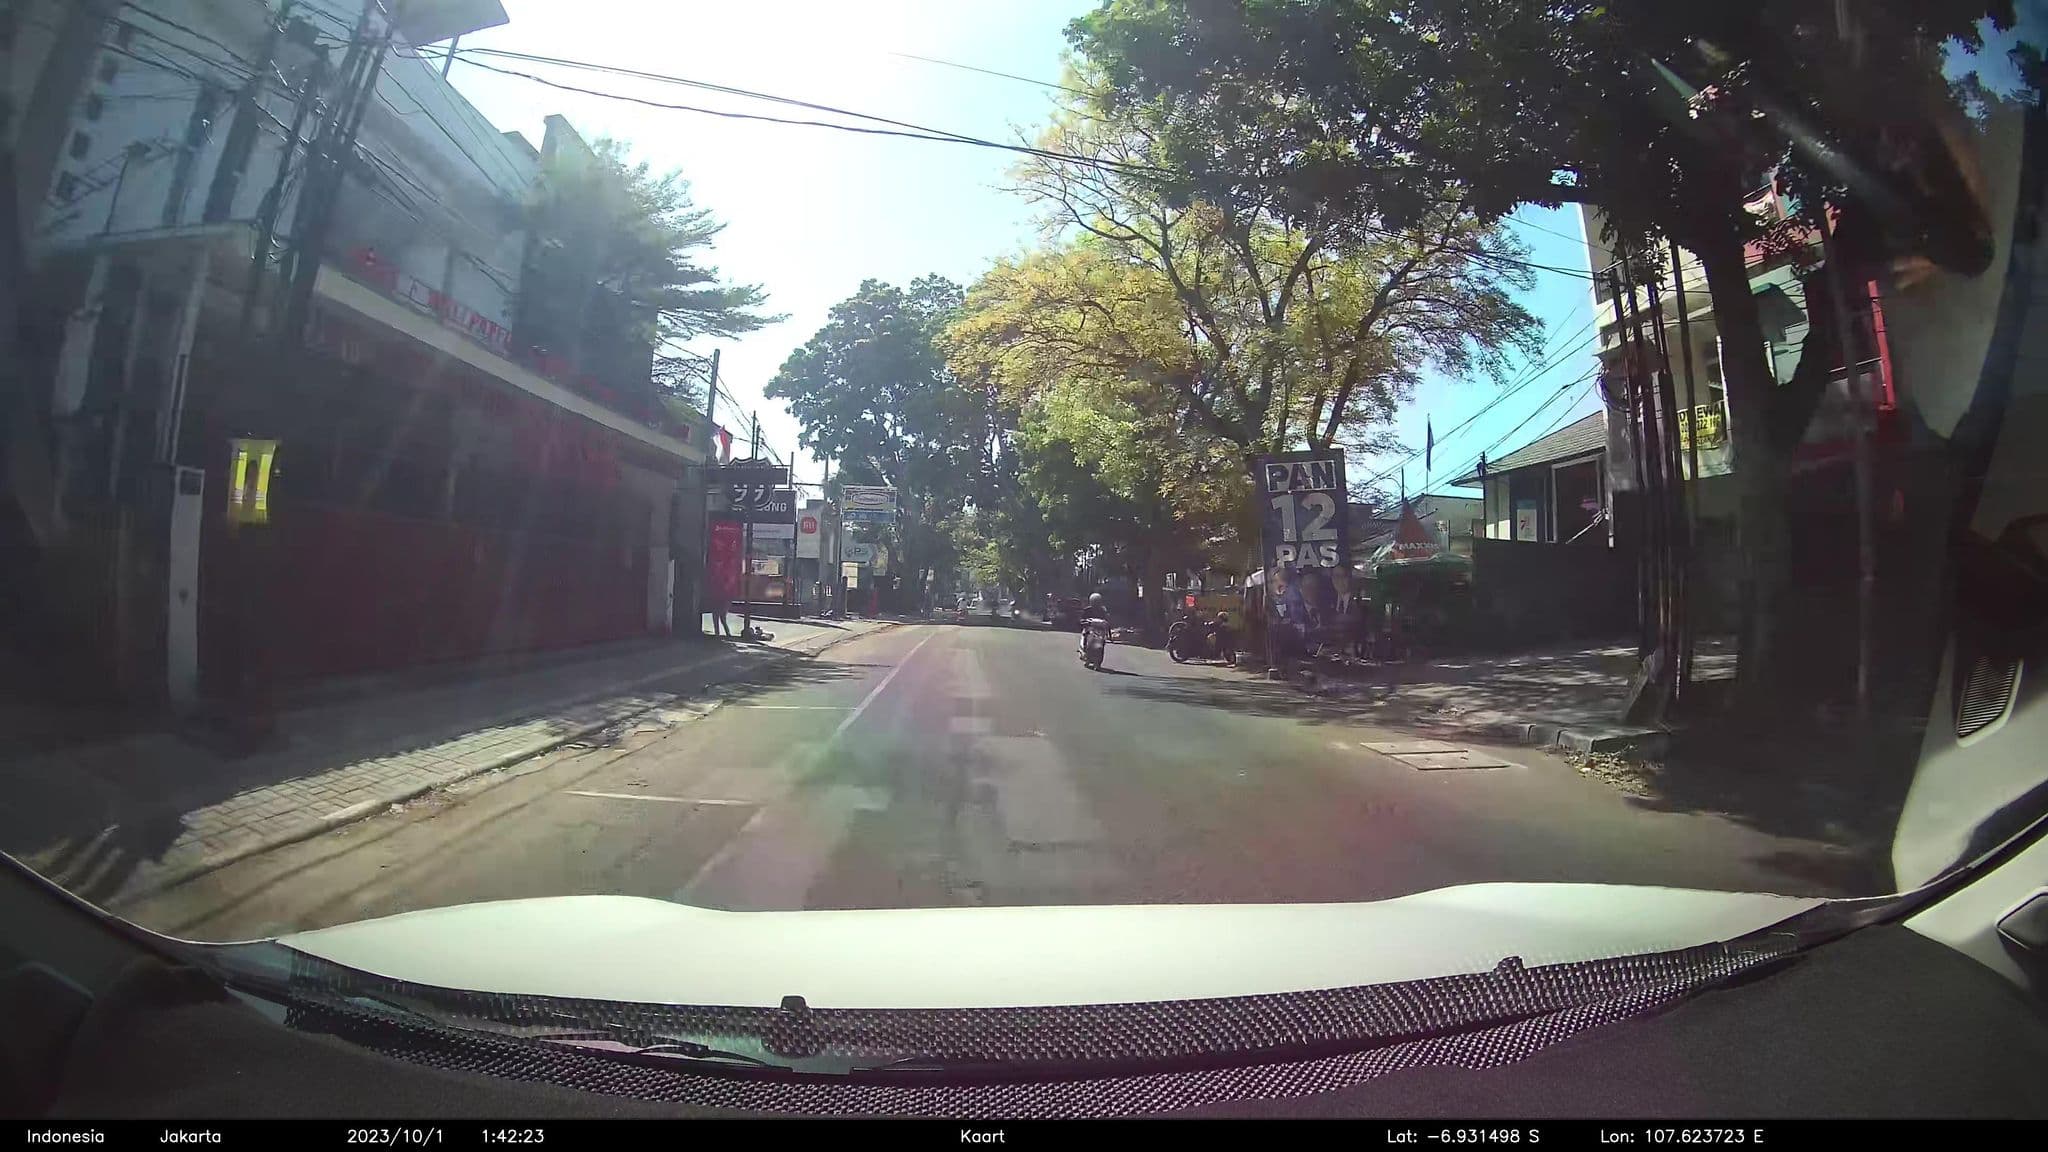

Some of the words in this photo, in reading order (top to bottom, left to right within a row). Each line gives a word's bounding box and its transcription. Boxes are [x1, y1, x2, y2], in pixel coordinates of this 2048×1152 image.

[1268, 462, 1334, 491] PAN
[1271, 493, 1338, 542] 12
[1276, 543, 1340, 568] PAS
